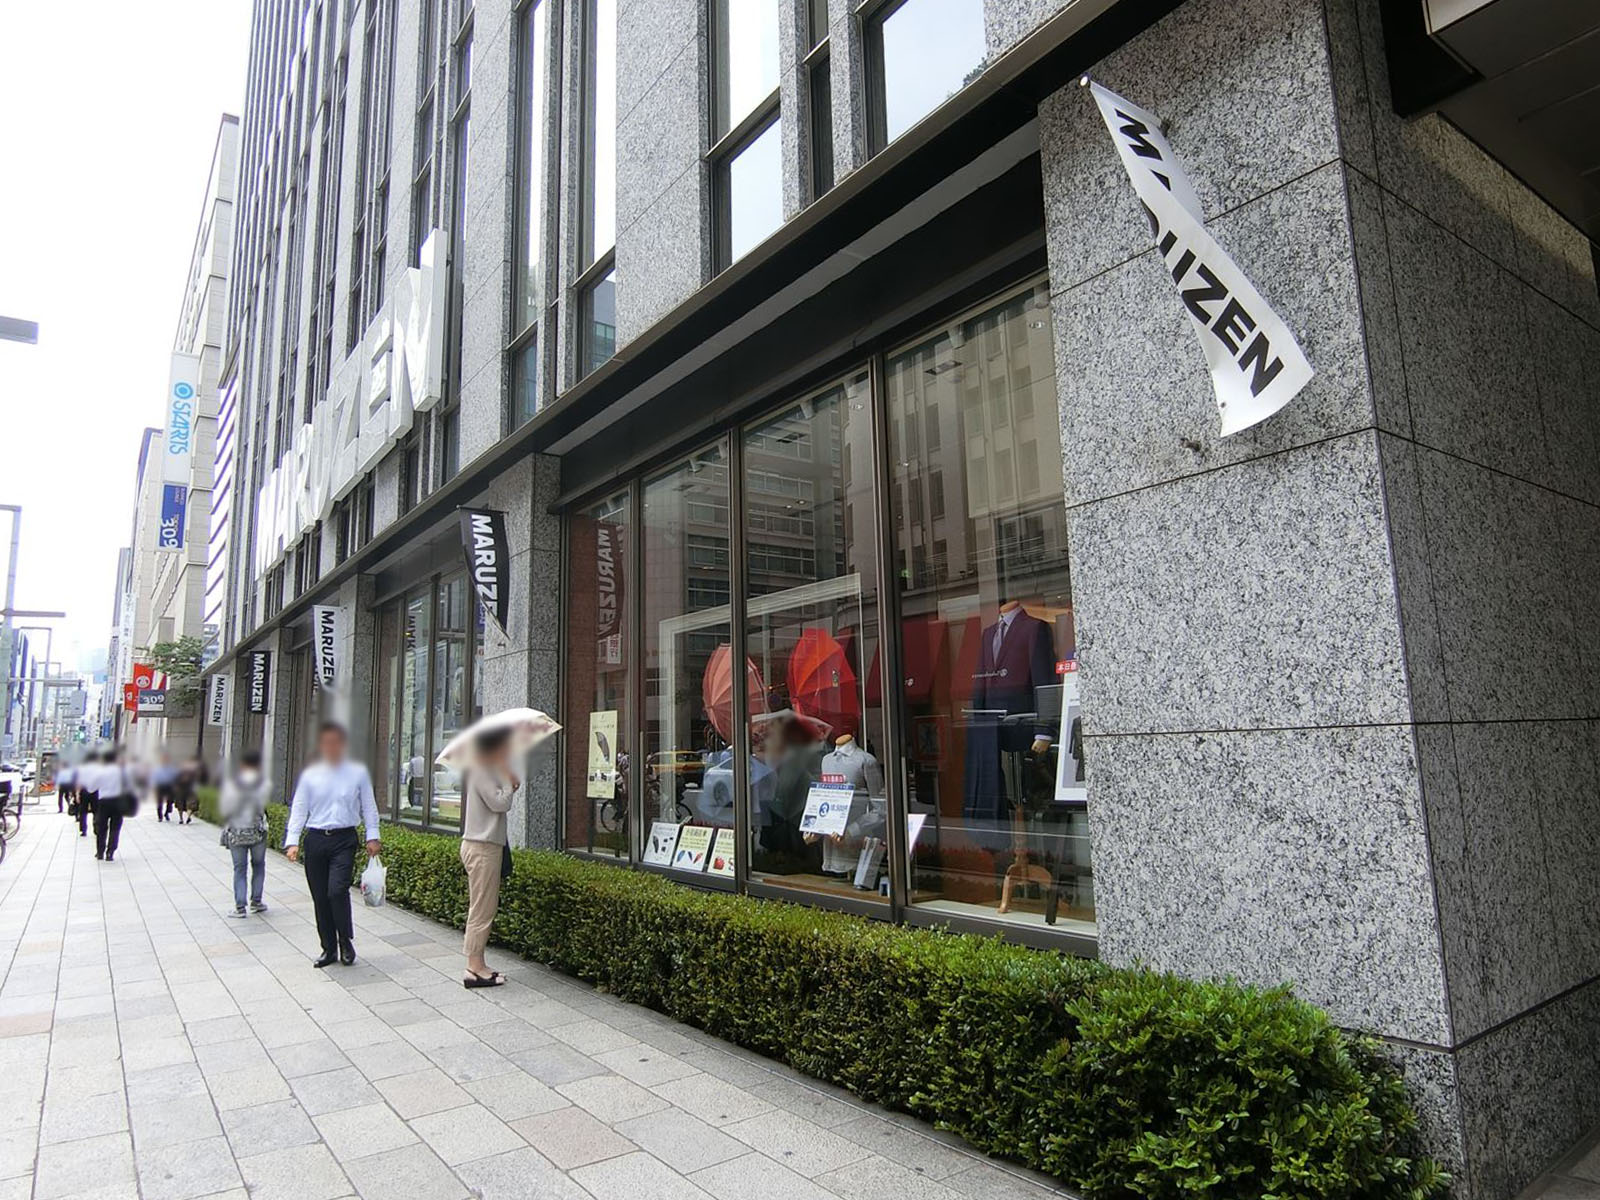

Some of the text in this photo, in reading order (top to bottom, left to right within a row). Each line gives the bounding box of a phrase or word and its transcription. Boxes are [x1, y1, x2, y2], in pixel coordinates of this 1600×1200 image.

[169, 401, 191, 455] STARTS
[471, 513, 498, 617] MARUZE
[213, 677, 226, 723] MARUZEN
[251, 653, 265, 712] MARUZEN
